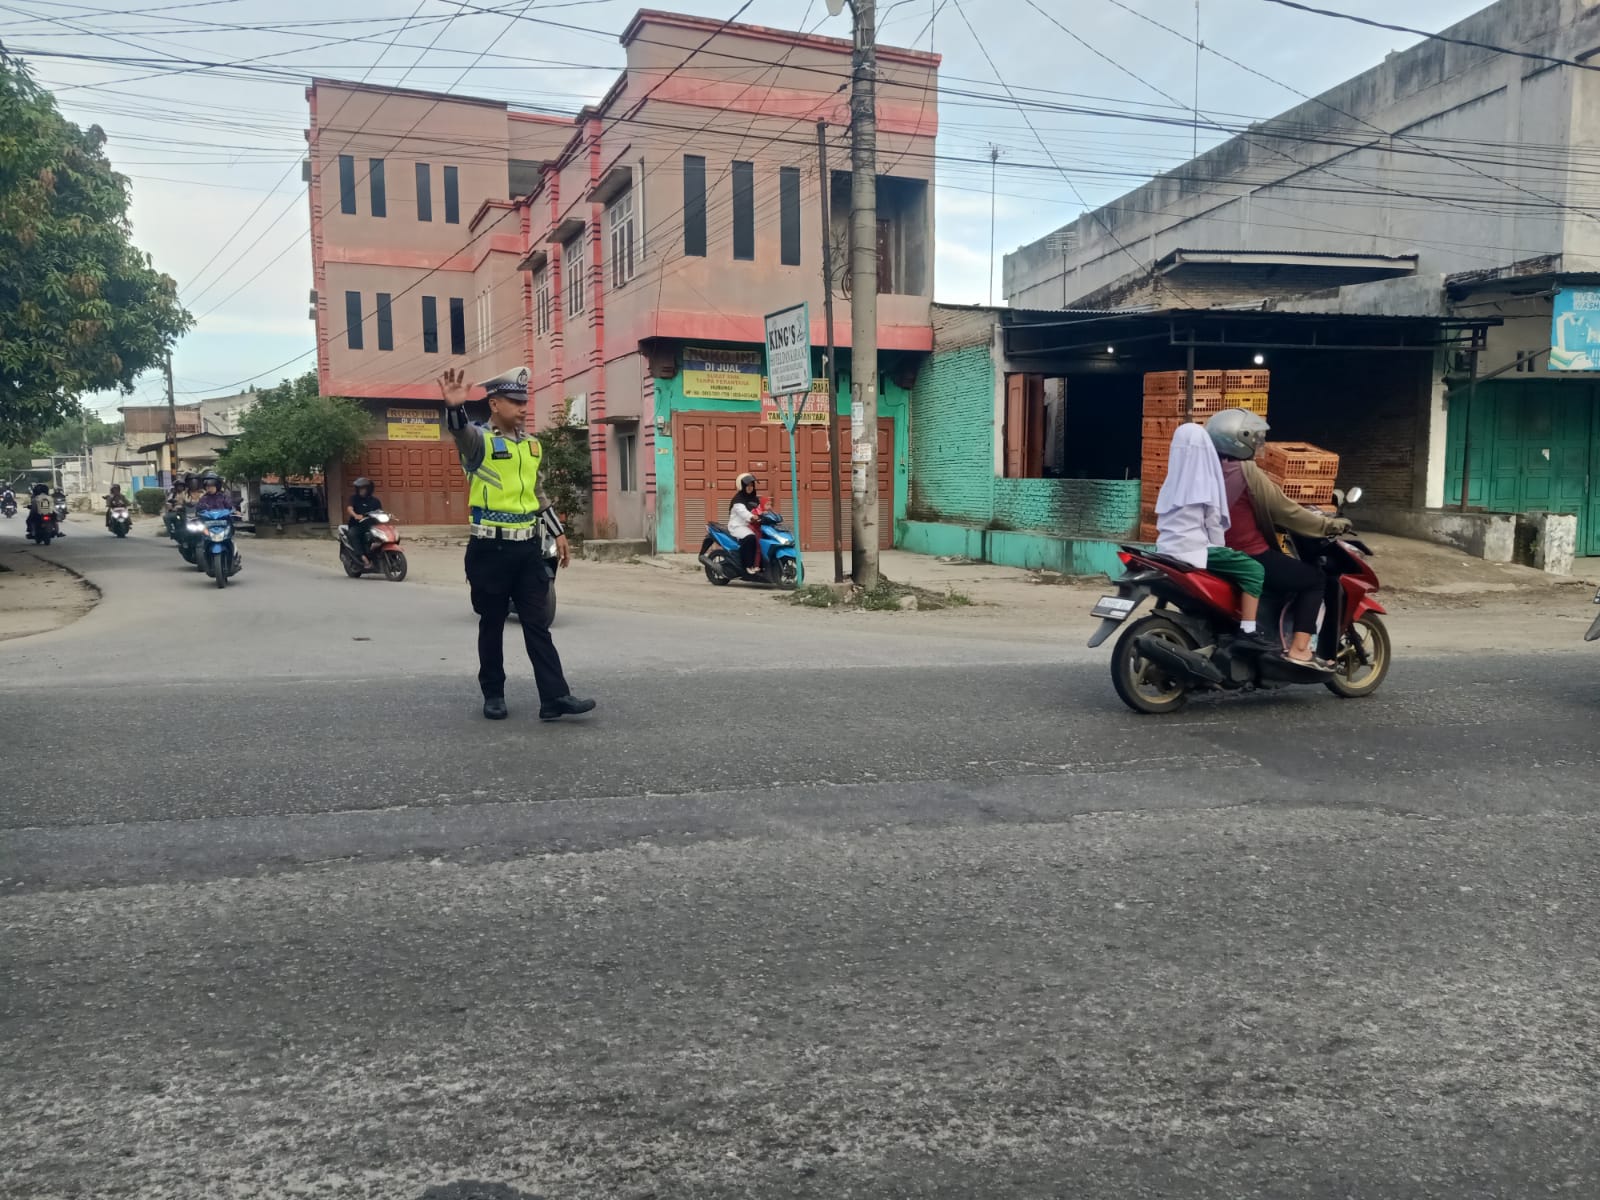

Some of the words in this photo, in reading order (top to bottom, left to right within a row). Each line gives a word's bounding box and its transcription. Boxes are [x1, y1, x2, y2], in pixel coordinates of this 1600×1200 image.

[769, 325, 796, 351] KING'S
[705, 362, 715, 371] DI
[717, 363, 741, 373] JUAL
[767, 412, 789, 421] TANA
